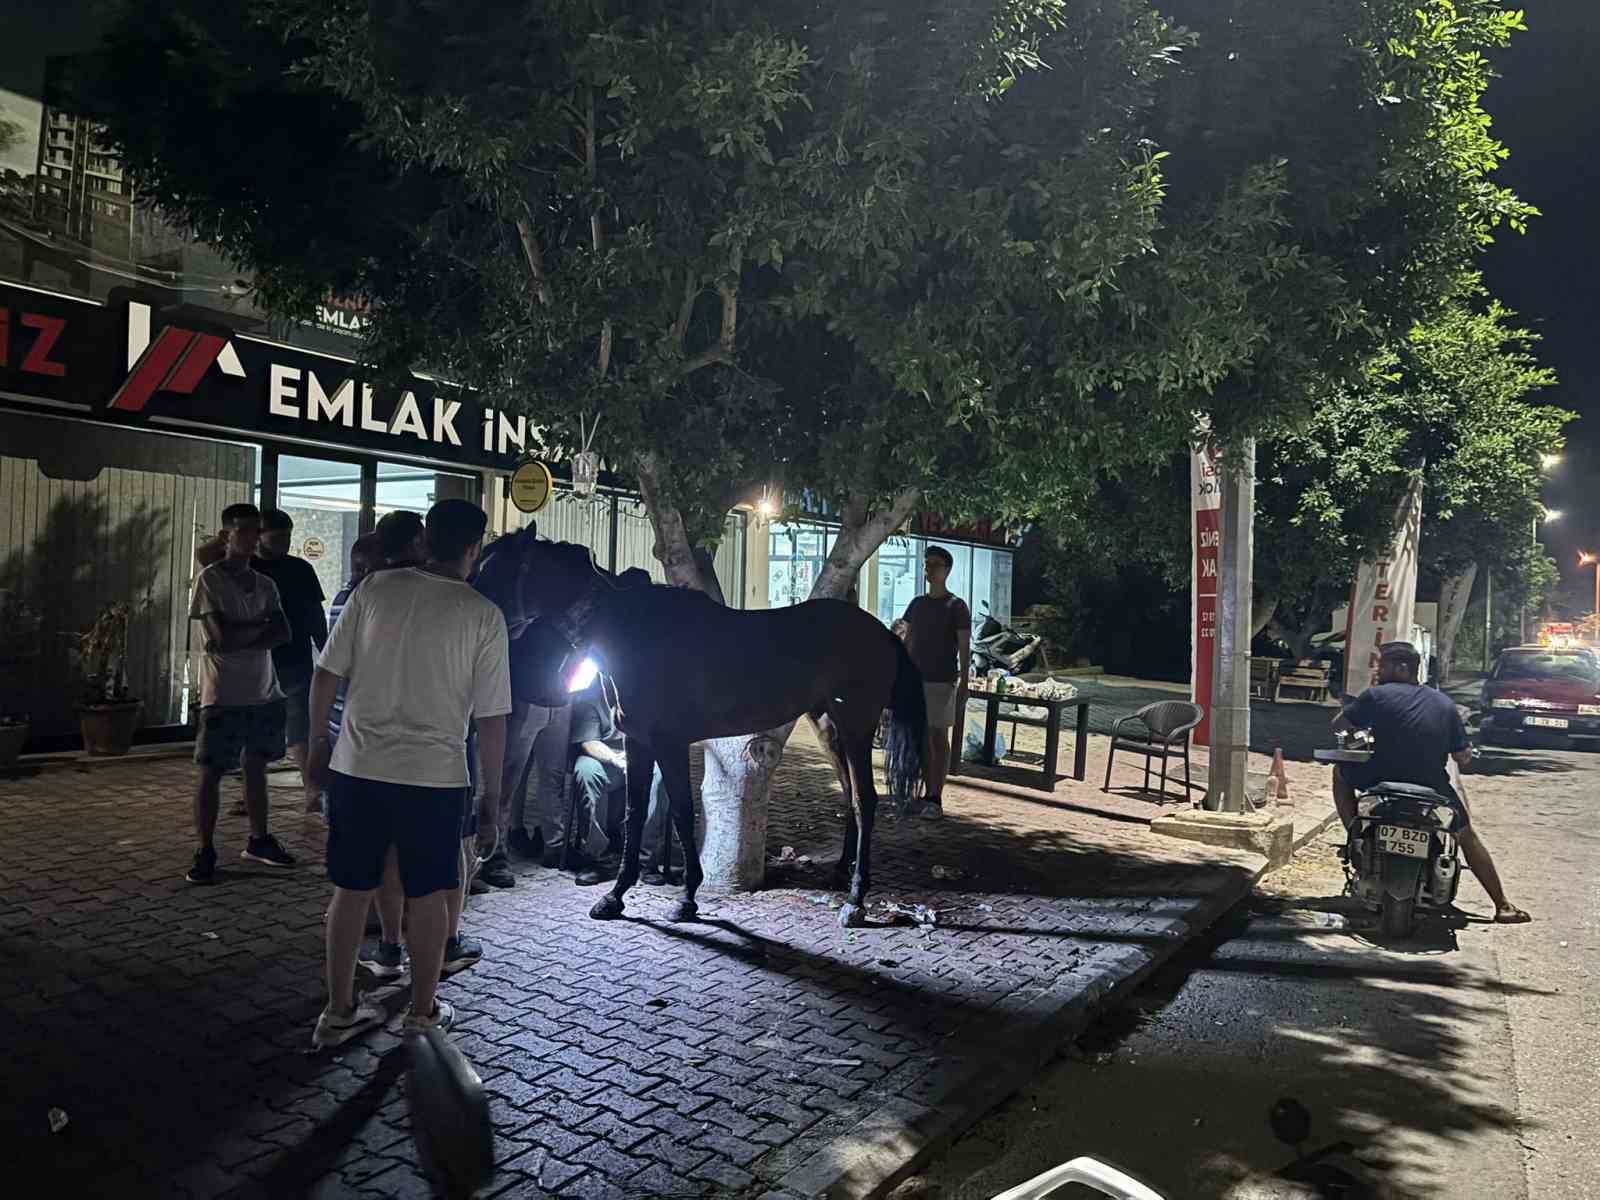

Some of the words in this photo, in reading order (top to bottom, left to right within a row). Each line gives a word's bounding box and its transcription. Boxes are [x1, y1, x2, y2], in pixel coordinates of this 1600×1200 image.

[268, 363, 463, 446] EMLAK
[1381, 826, 1397, 838] 07
[1402, 830, 1428, 843] BZD
[1390, 840, 1415, 854] 755
